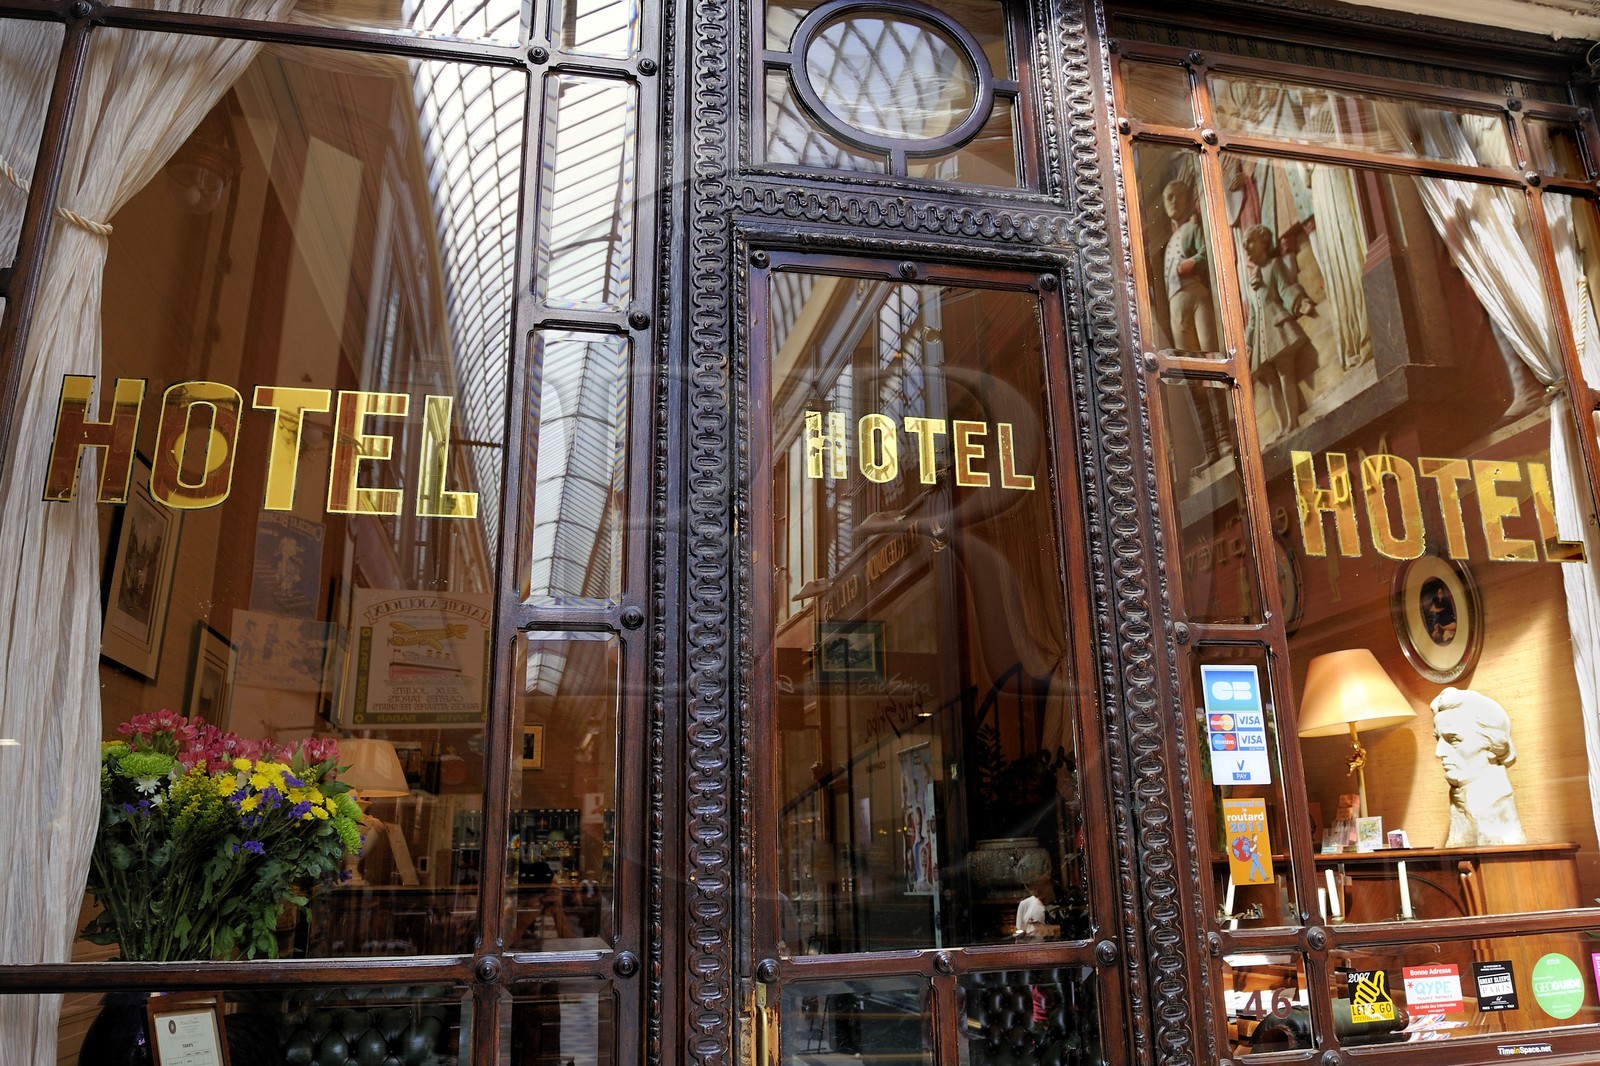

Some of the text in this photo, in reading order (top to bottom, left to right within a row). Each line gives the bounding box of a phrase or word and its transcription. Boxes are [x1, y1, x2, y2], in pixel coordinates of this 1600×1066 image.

[42, 373, 479, 519] HOTEL
[805, 410, 1035, 491] HOTEL
[1290, 450, 1587, 563] HOTEL
[1239, 716, 1260, 725] VISA
[1241, 735, 1262, 744] VISA
[1226, 811, 1265, 822] routard
[1229, 821, 1264, 833] 2011
[1348, 971, 1371, 983] 2007
[1415, 981, 1451, 995] QYPE
[1243, 987, 1293, 1021] 46
[1379, 1002, 1392, 1014] GO
[1497, 1046, 1552, 1055] TimeinSpace.net
